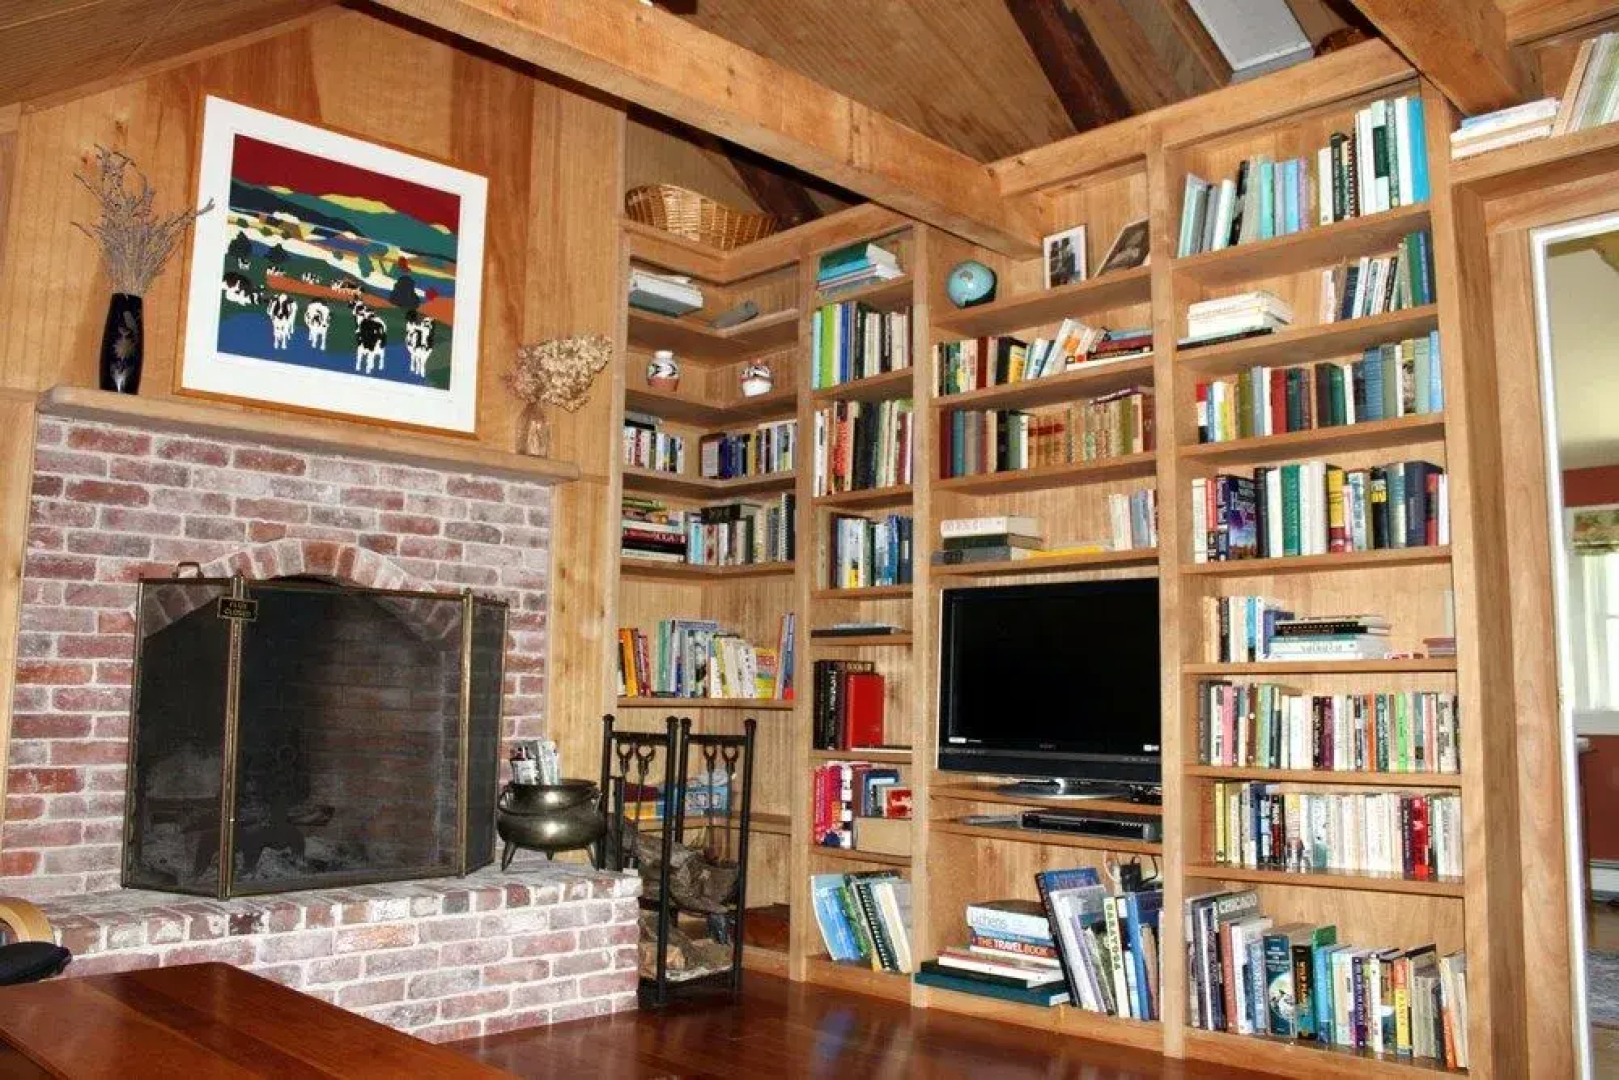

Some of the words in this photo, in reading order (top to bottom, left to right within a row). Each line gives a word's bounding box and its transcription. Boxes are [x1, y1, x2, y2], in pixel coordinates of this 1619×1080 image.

[978, 936, 993, 948] THE
[993, 938, 1023, 954] TRAVEL
[1023, 944, 1048, 957] BOOK
